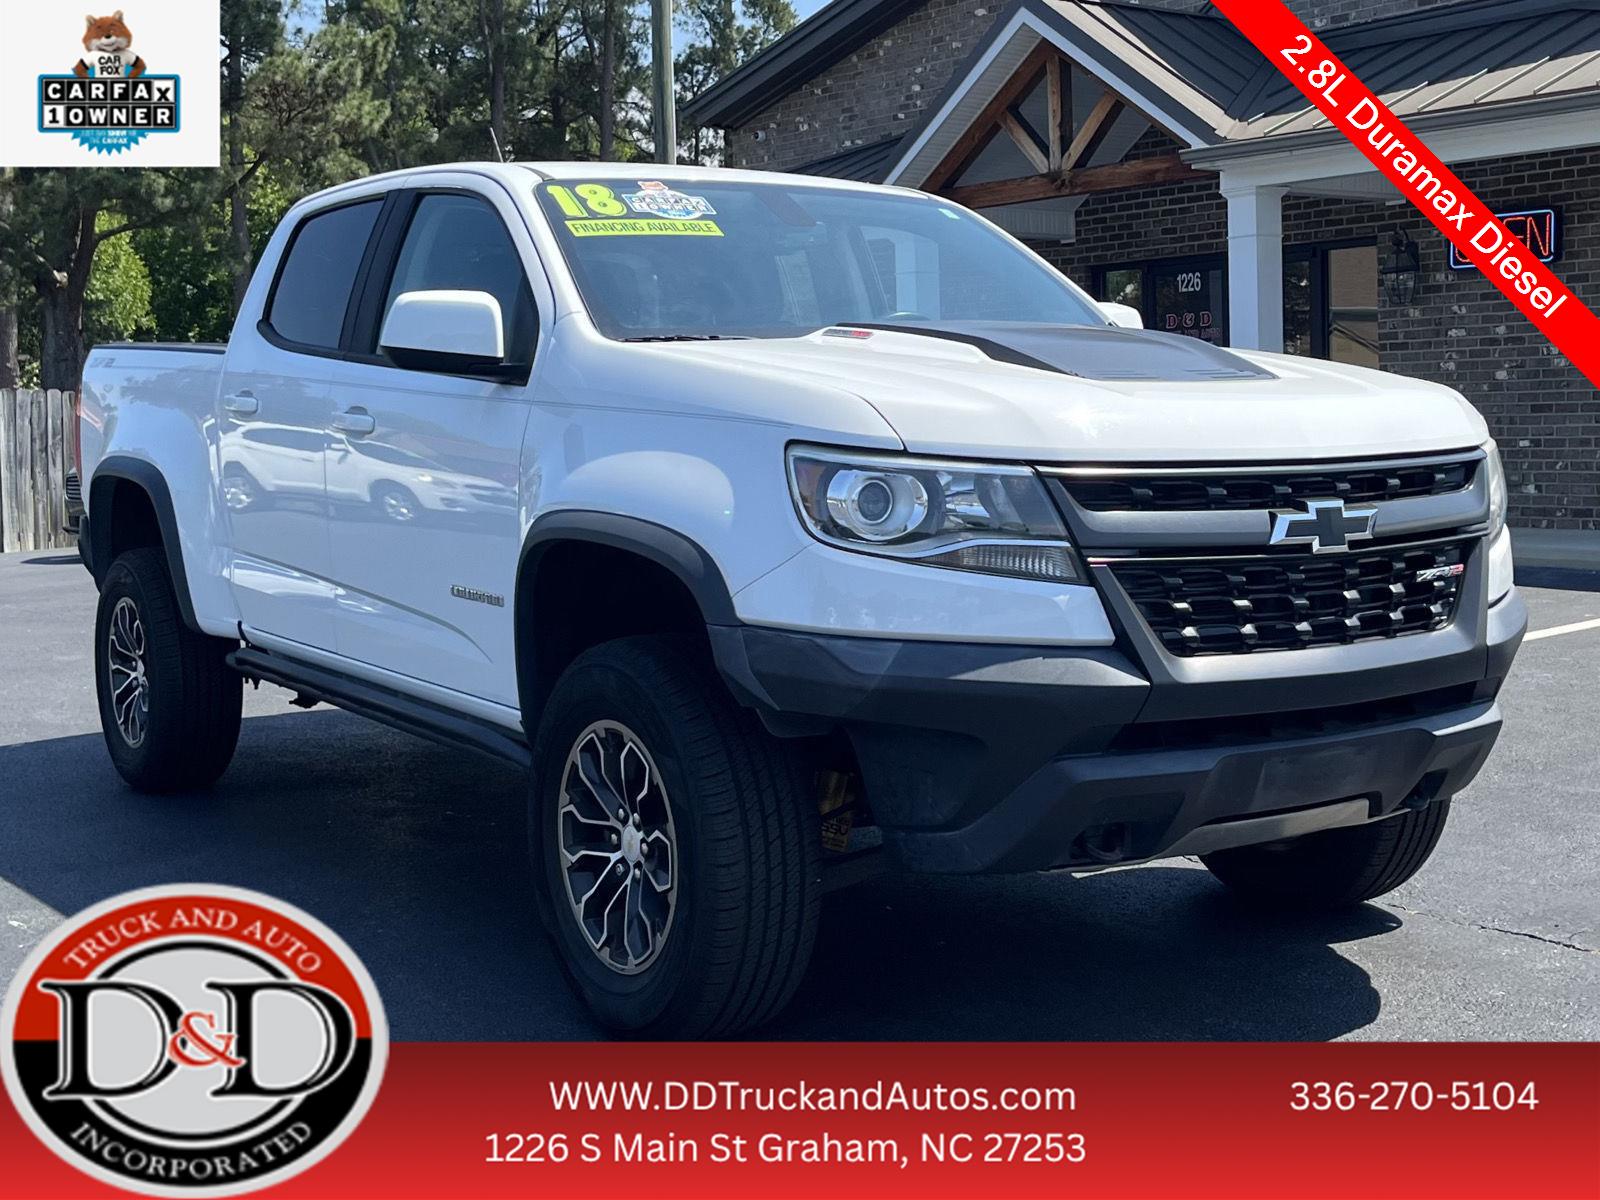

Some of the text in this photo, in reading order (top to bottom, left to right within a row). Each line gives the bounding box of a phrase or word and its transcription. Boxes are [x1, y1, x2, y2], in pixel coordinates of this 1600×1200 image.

[547, 184, 627, 217] 18
[572, 223, 717, 233] FINANCING AVAILABLE
[1177, 272, 1201, 292] 1226
[1166, 314, 1178, 329] D
[1200, 311, 1212, 327] D
